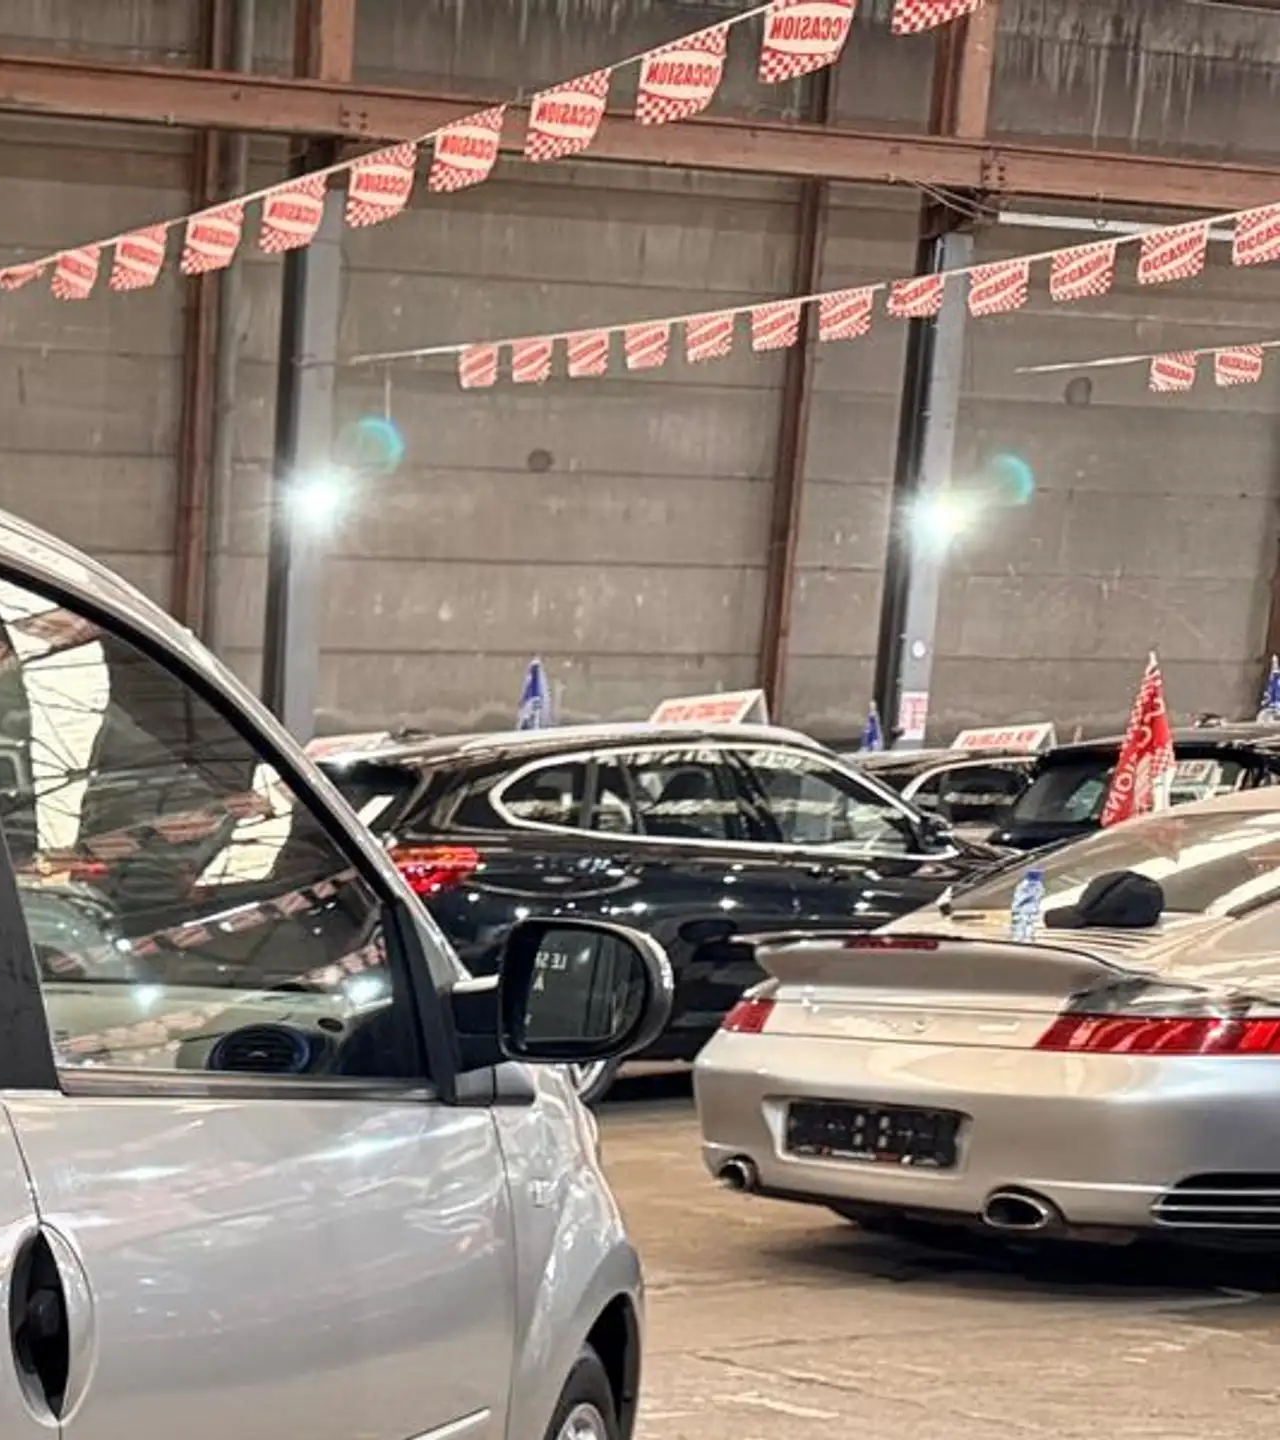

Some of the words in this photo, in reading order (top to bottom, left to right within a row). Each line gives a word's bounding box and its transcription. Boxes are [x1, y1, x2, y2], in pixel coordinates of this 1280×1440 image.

[1052, 254, 1110, 291] OCCASION
[1142, 235, 1204, 273] OCCASION
[970, 270, 1026, 306] OCCASION
